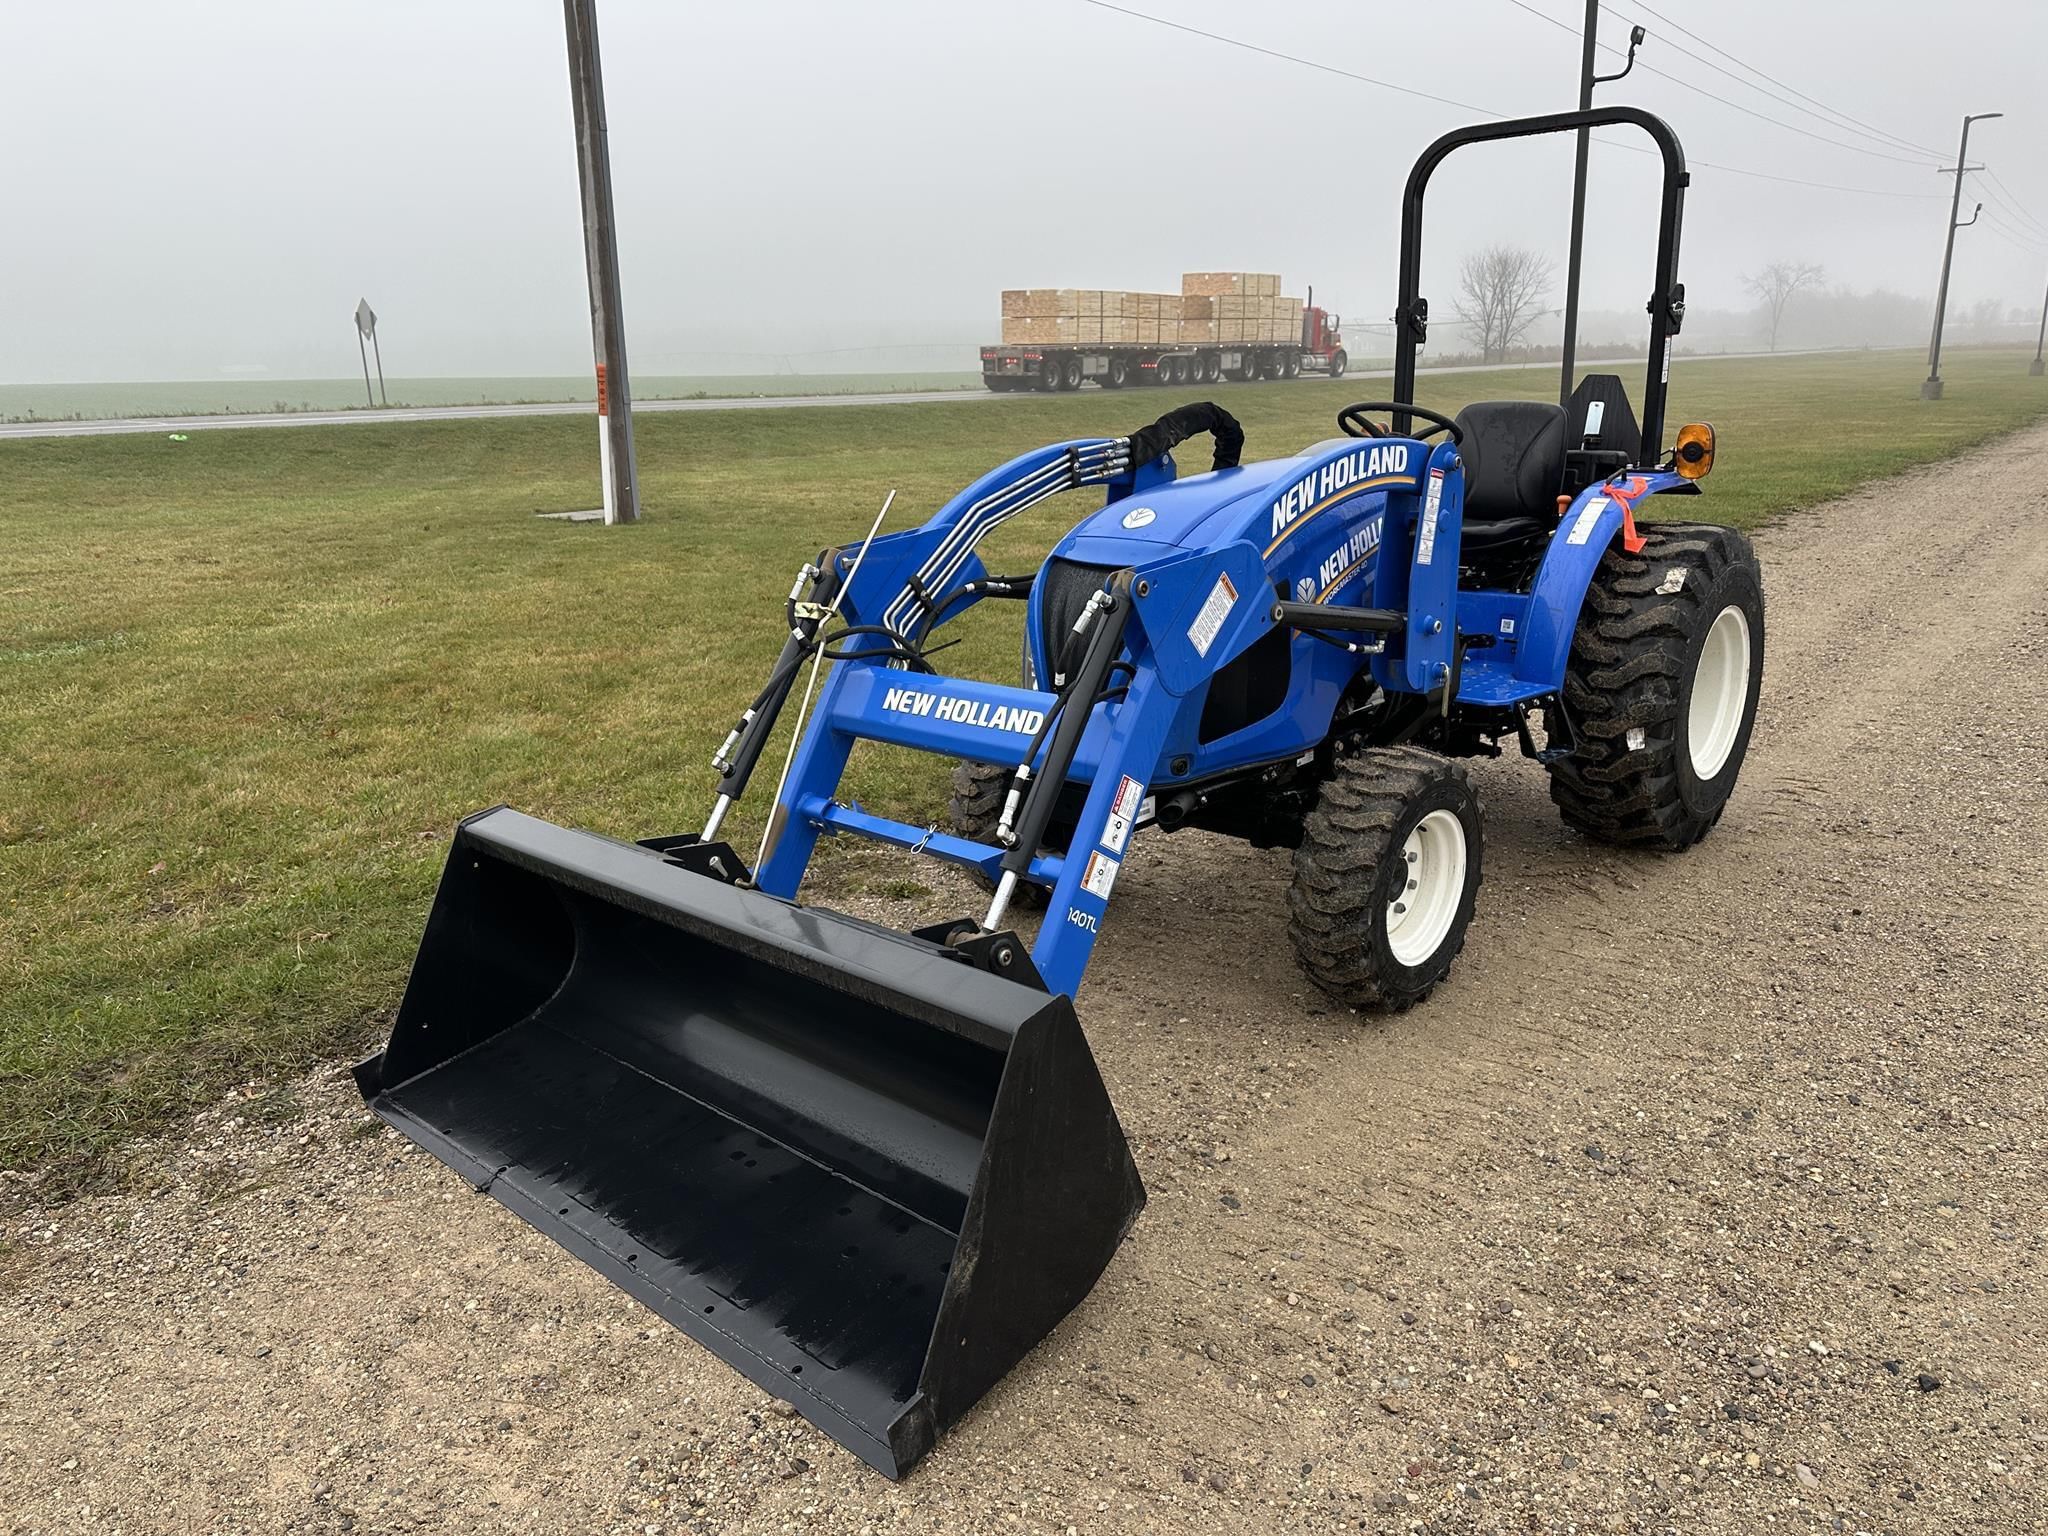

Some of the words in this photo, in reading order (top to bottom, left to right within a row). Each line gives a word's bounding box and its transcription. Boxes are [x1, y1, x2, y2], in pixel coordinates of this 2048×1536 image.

[1272, 471, 1317, 538] NEW
[1319, 445, 1408, 499] HOLLAND
[1320, 543, 1349, 590] NEW
[1349, 517, 1383, 561] HOLL
[882, 688, 936, 716] NEW
[935, 696, 1044, 735] HOLLAND
[1116, 779, 1128, 805] DANGER
[1067, 906, 1097, 934] 140TL
